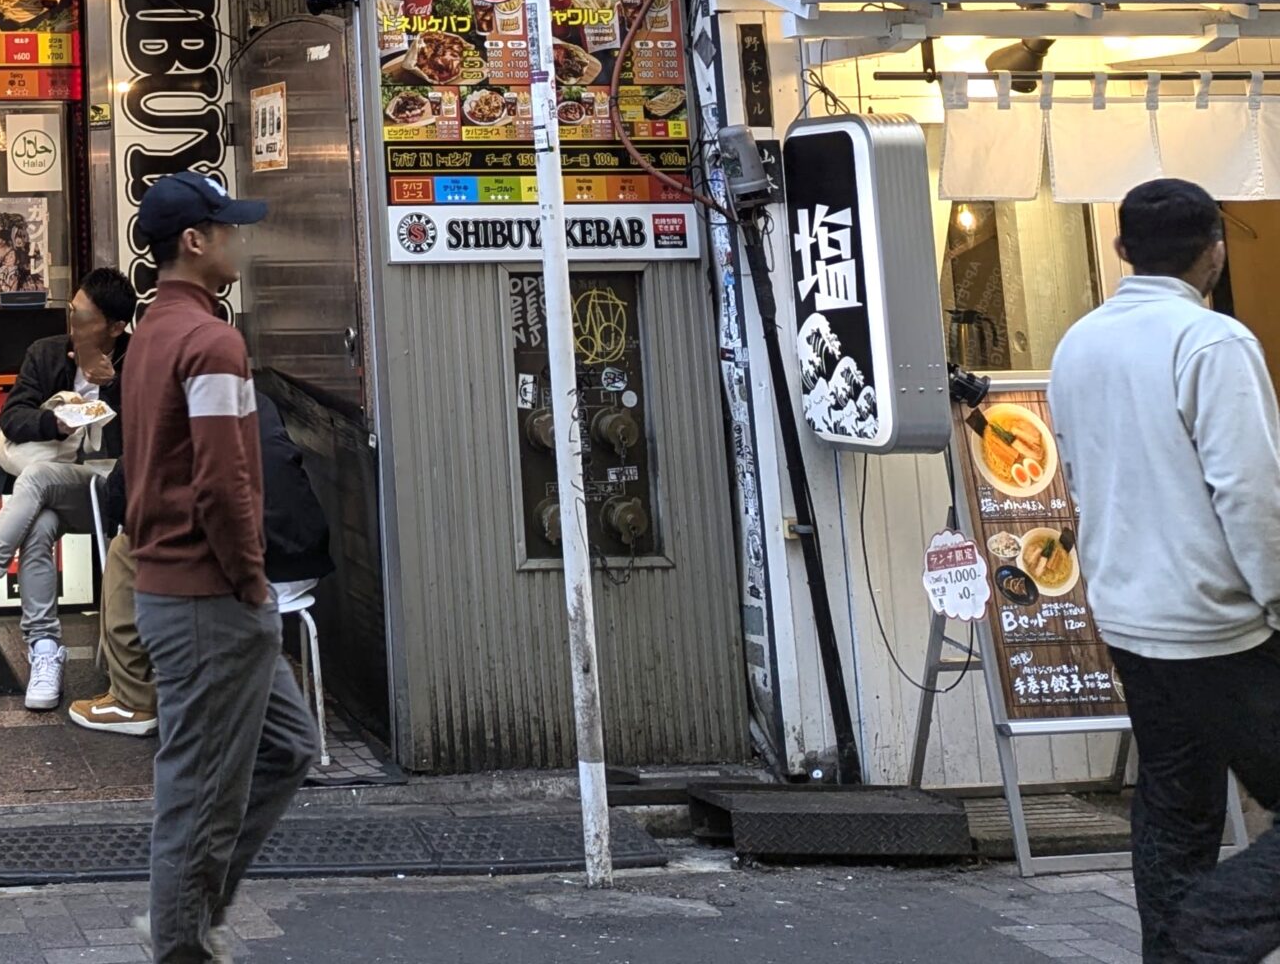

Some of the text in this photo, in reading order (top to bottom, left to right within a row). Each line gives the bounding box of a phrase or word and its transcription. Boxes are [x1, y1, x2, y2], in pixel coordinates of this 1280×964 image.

[13, 52, 30, 61] ¥600
[387, 128, 420, 136] ビッグケバブ
[22, 159, 46, 168] Halal
[419, 153, 433, 166] IN
[485, 153, 512, 166] チーズ
[517, 153, 536, 166] 150
[402, 182, 423, 190] ケバブ
[403, 190, 423, 198] ソース
[446, 217, 648, 250] SHIBUY KEBAB
[793, 203, 864, 312] 塩
[930, 547, 974, 565] ランチ限定
